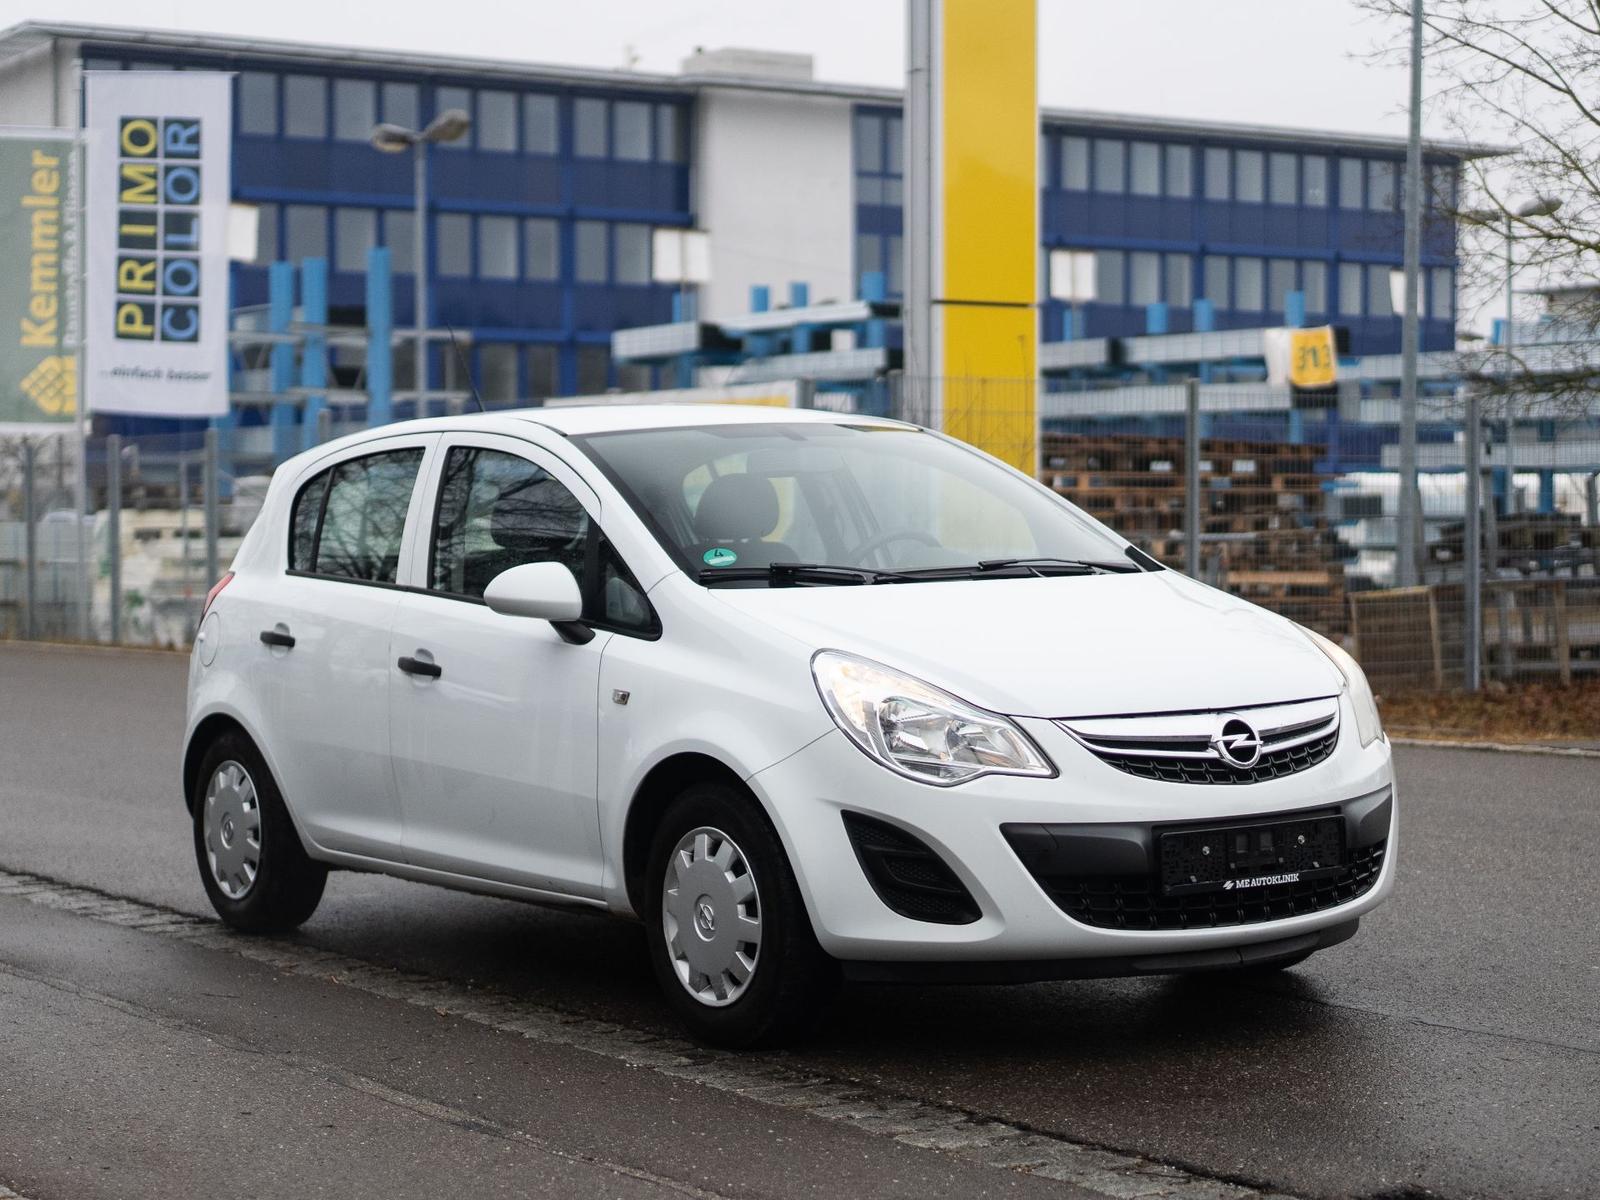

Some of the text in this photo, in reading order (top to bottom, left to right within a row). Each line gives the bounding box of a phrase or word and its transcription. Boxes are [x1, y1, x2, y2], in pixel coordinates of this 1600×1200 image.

[20, 150, 60, 347] Kemmler
[117, 119, 158, 336] PRIMO
[163, 123, 199, 339] COLOR
[1236, 873, 1299, 889] ME AUTOKLINIK
